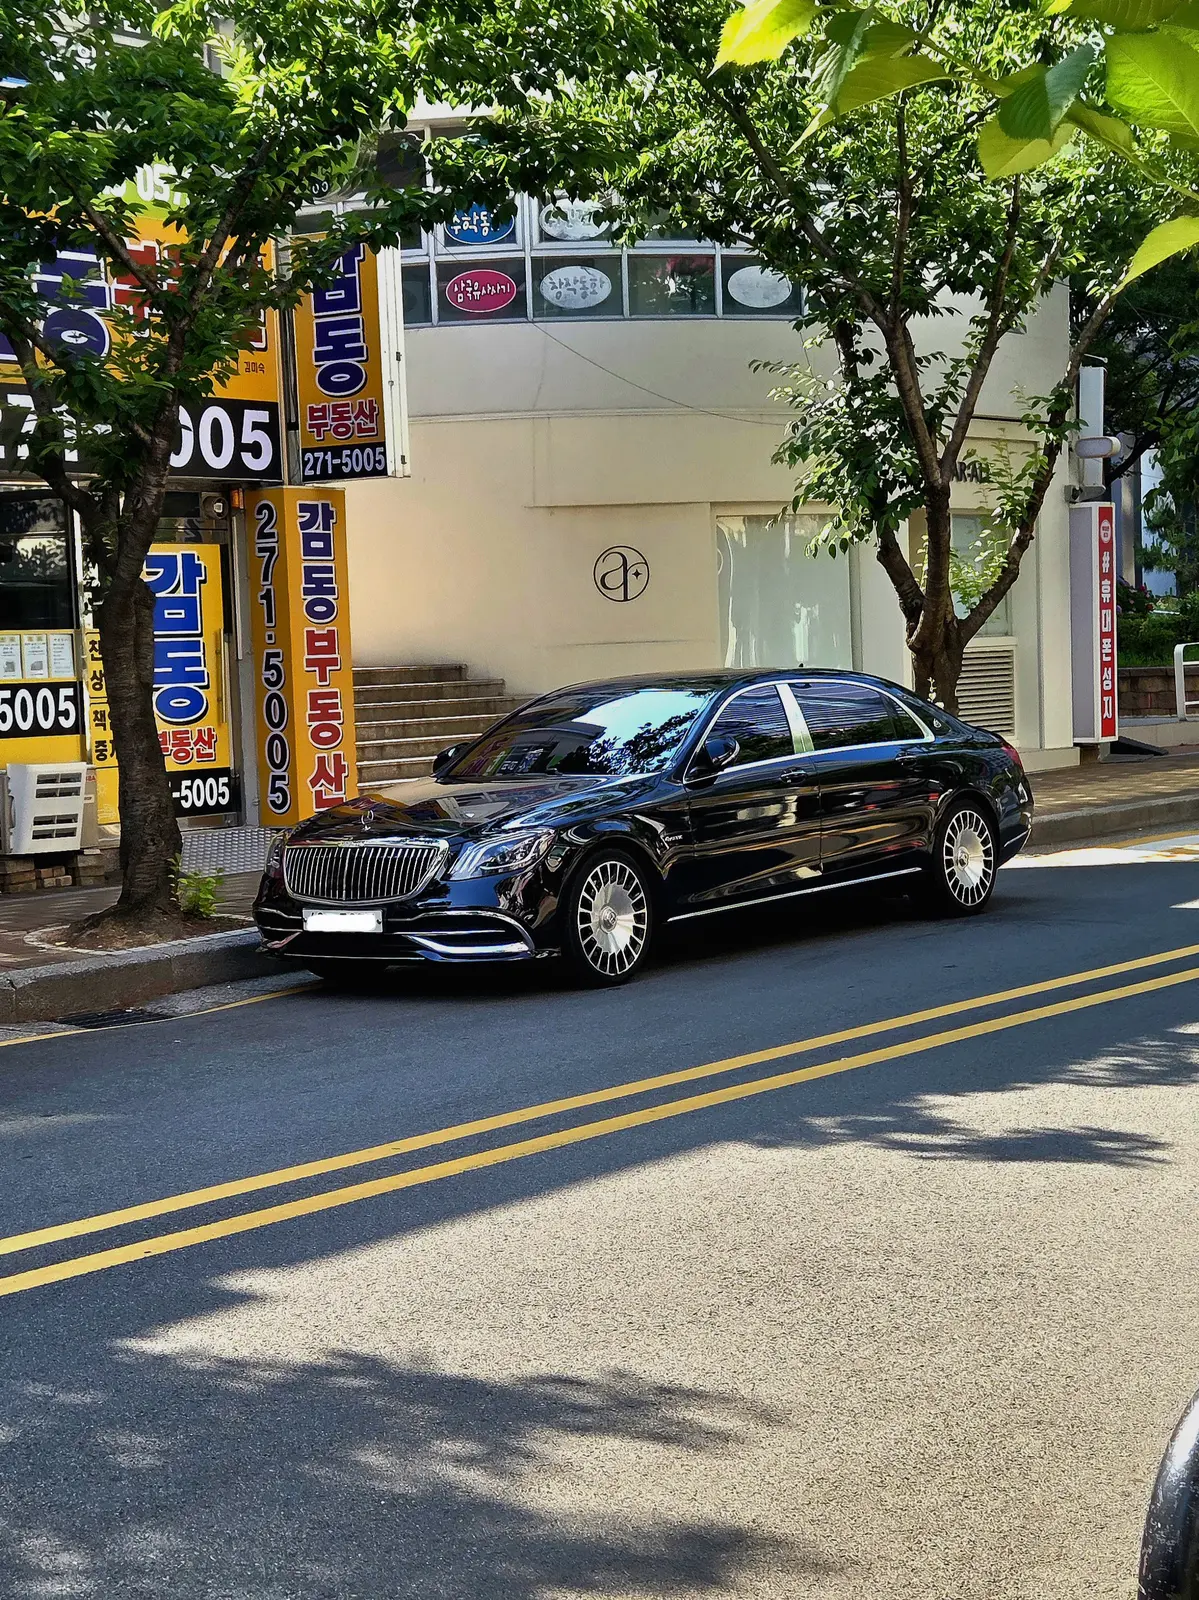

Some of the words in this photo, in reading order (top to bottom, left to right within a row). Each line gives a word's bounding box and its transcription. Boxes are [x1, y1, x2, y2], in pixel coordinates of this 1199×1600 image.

[450, 206, 500, 237] 수학동
[243, 361, 265, 375] 김미숙
[307, 399, 379, 441] 부동산
[304, 446, 386, 477] 271-5005
[0, 687, 77, 732] 5005
[168, 776, 230, 809] -5005
